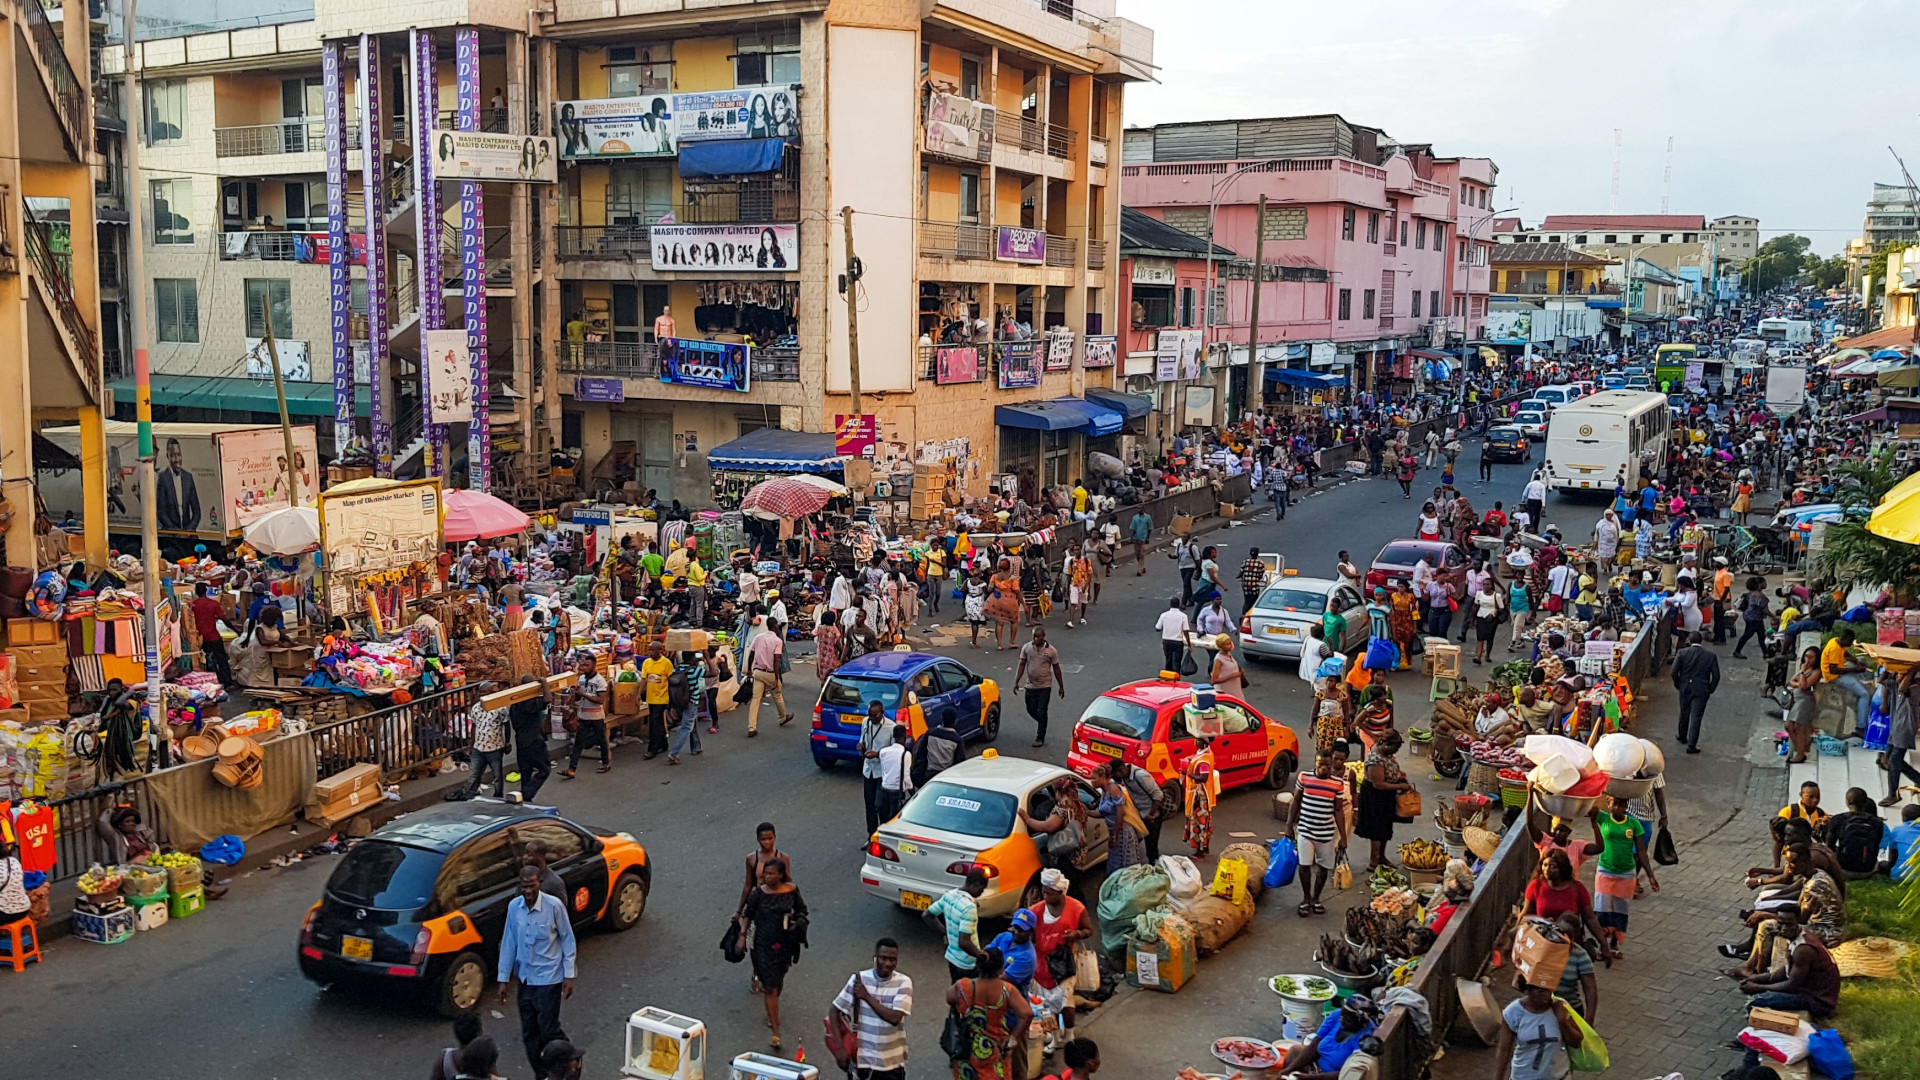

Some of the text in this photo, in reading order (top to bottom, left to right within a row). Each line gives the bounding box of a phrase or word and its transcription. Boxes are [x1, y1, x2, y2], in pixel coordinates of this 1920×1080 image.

[686, 227, 725, 235] COMPANY
[728, 227, 760, 235] LIMTED
[394, 491, 414, 500] Market
[574, 510, 601, 519] KNUTSFORD
[1232, 750, 1268, 761] PFLEGE ZUHAUSE
[947, 800, 979, 811] SHADDAI
[26, 824, 48, 840] USA
